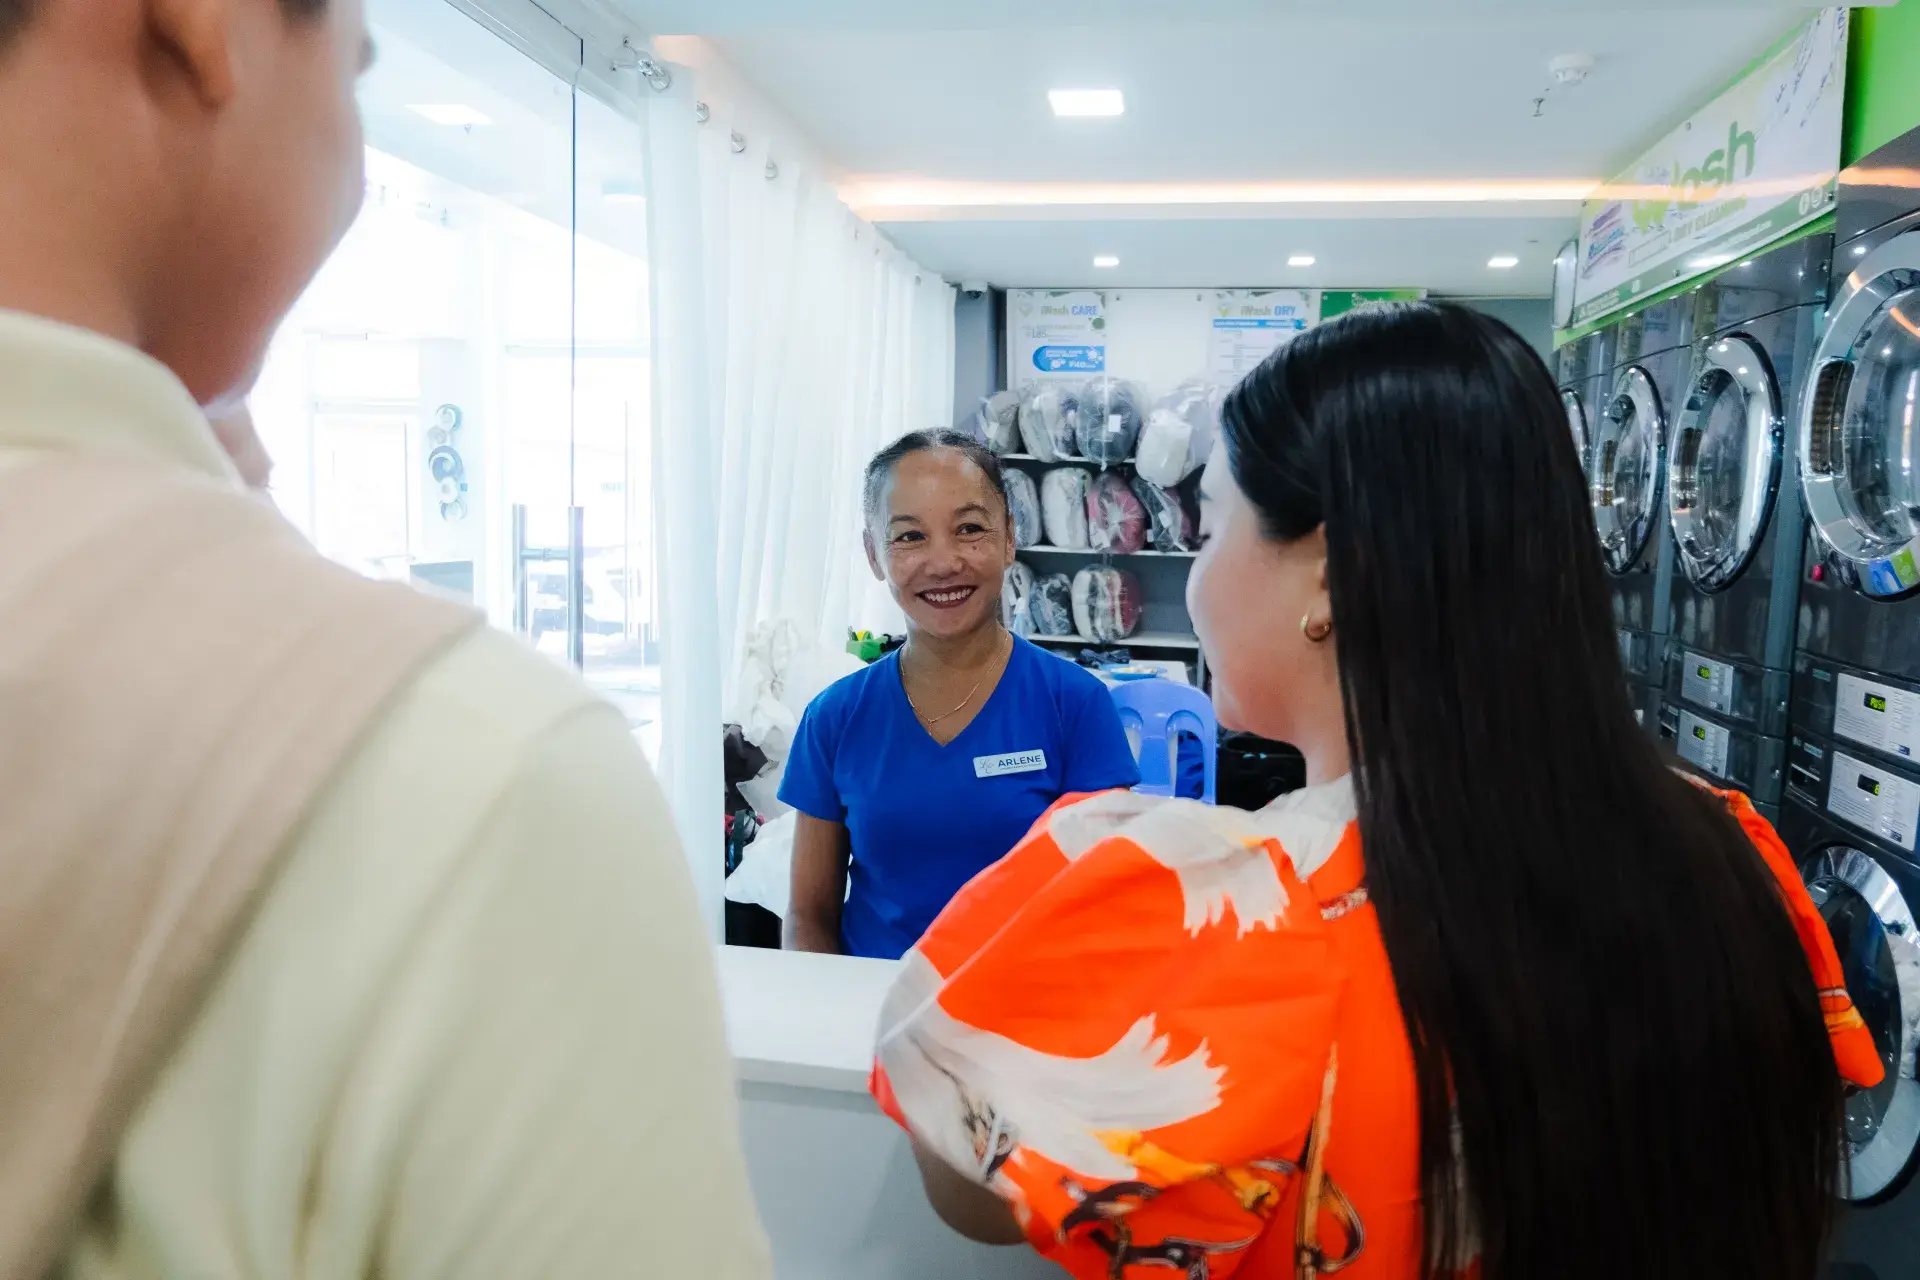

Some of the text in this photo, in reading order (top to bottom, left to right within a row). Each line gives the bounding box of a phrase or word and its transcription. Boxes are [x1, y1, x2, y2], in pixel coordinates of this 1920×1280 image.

[1072, 304, 1098, 316] CARE
[1274, 304, 1296, 316] DRY
[998, 754, 1041, 767] ARLENE
